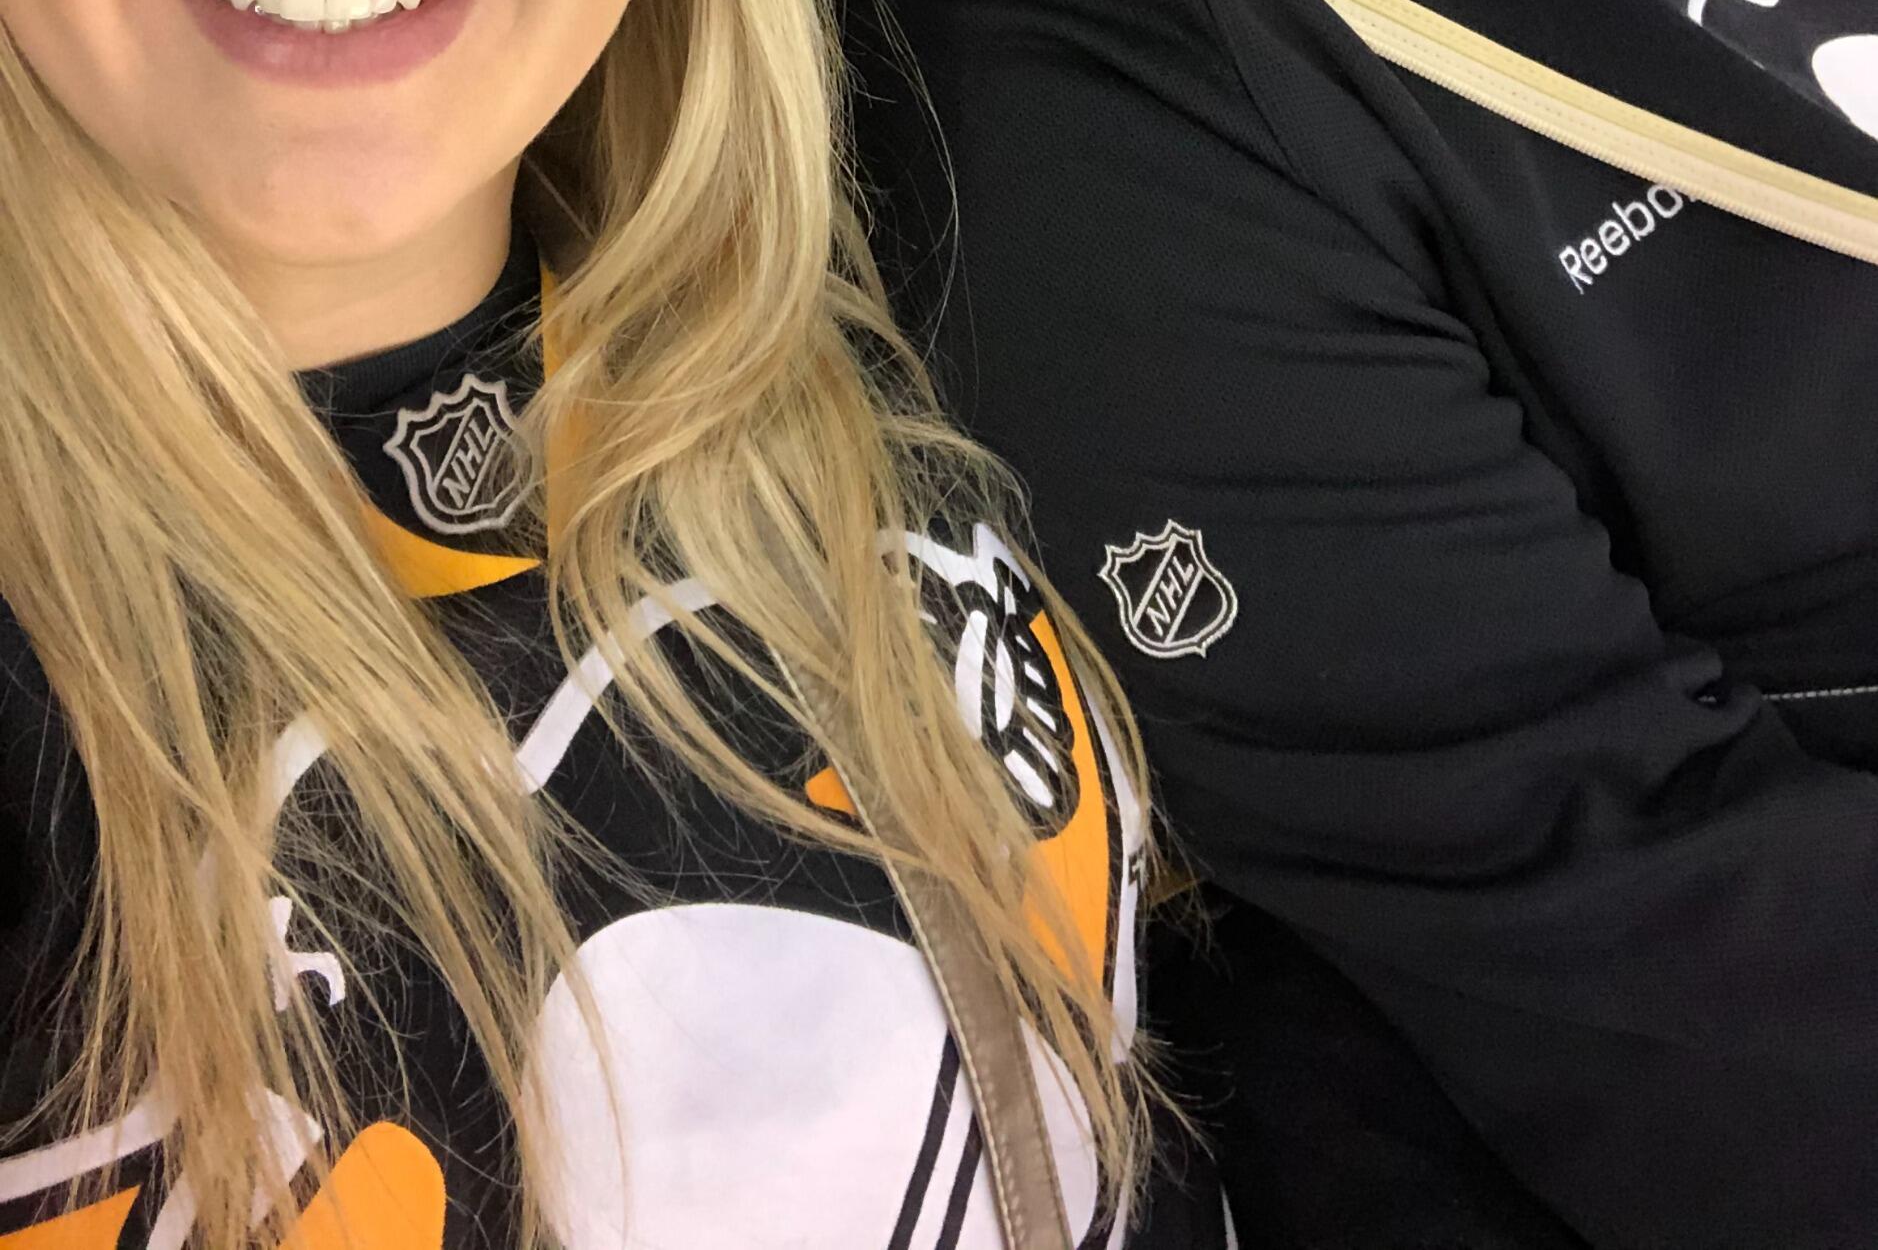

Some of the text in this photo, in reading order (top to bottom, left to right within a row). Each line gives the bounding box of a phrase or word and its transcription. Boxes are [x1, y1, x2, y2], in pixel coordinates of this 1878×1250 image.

[1558, 183, 1698, 295] Reebo
[442, 418, 496, 509] NHL
[1145, 555, 1195, 637] NHL
